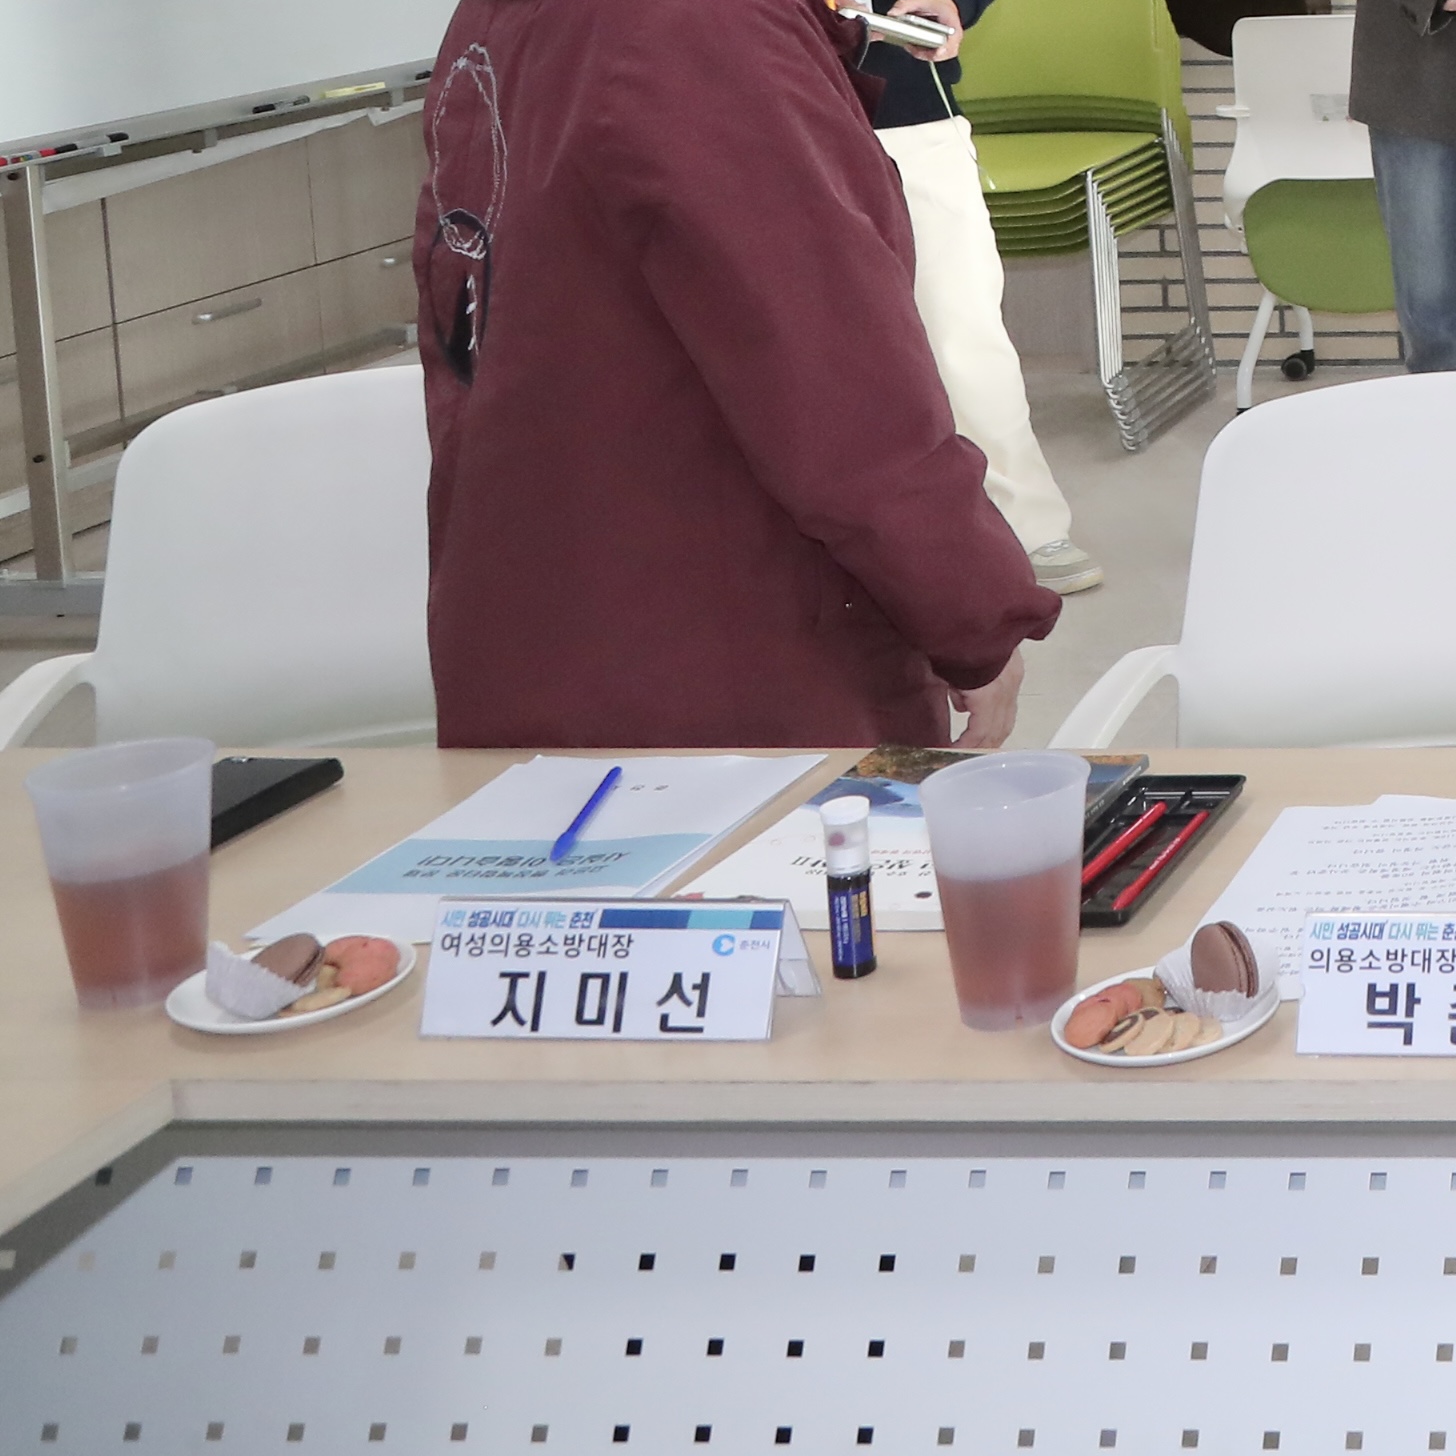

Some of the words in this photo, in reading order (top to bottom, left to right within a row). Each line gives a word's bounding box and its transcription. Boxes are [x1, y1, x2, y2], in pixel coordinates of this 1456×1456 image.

[467, 910, 516, 928] 성공시대
[569, 910, 595, 929] 춘천
[1310, 921, 1334, 940] 시민
[1337, 921, 1386, 940] 성공시대
[1388, 922, 1412, 940] 다시
[441, 933, 635, 959] 여성의용소방대장
